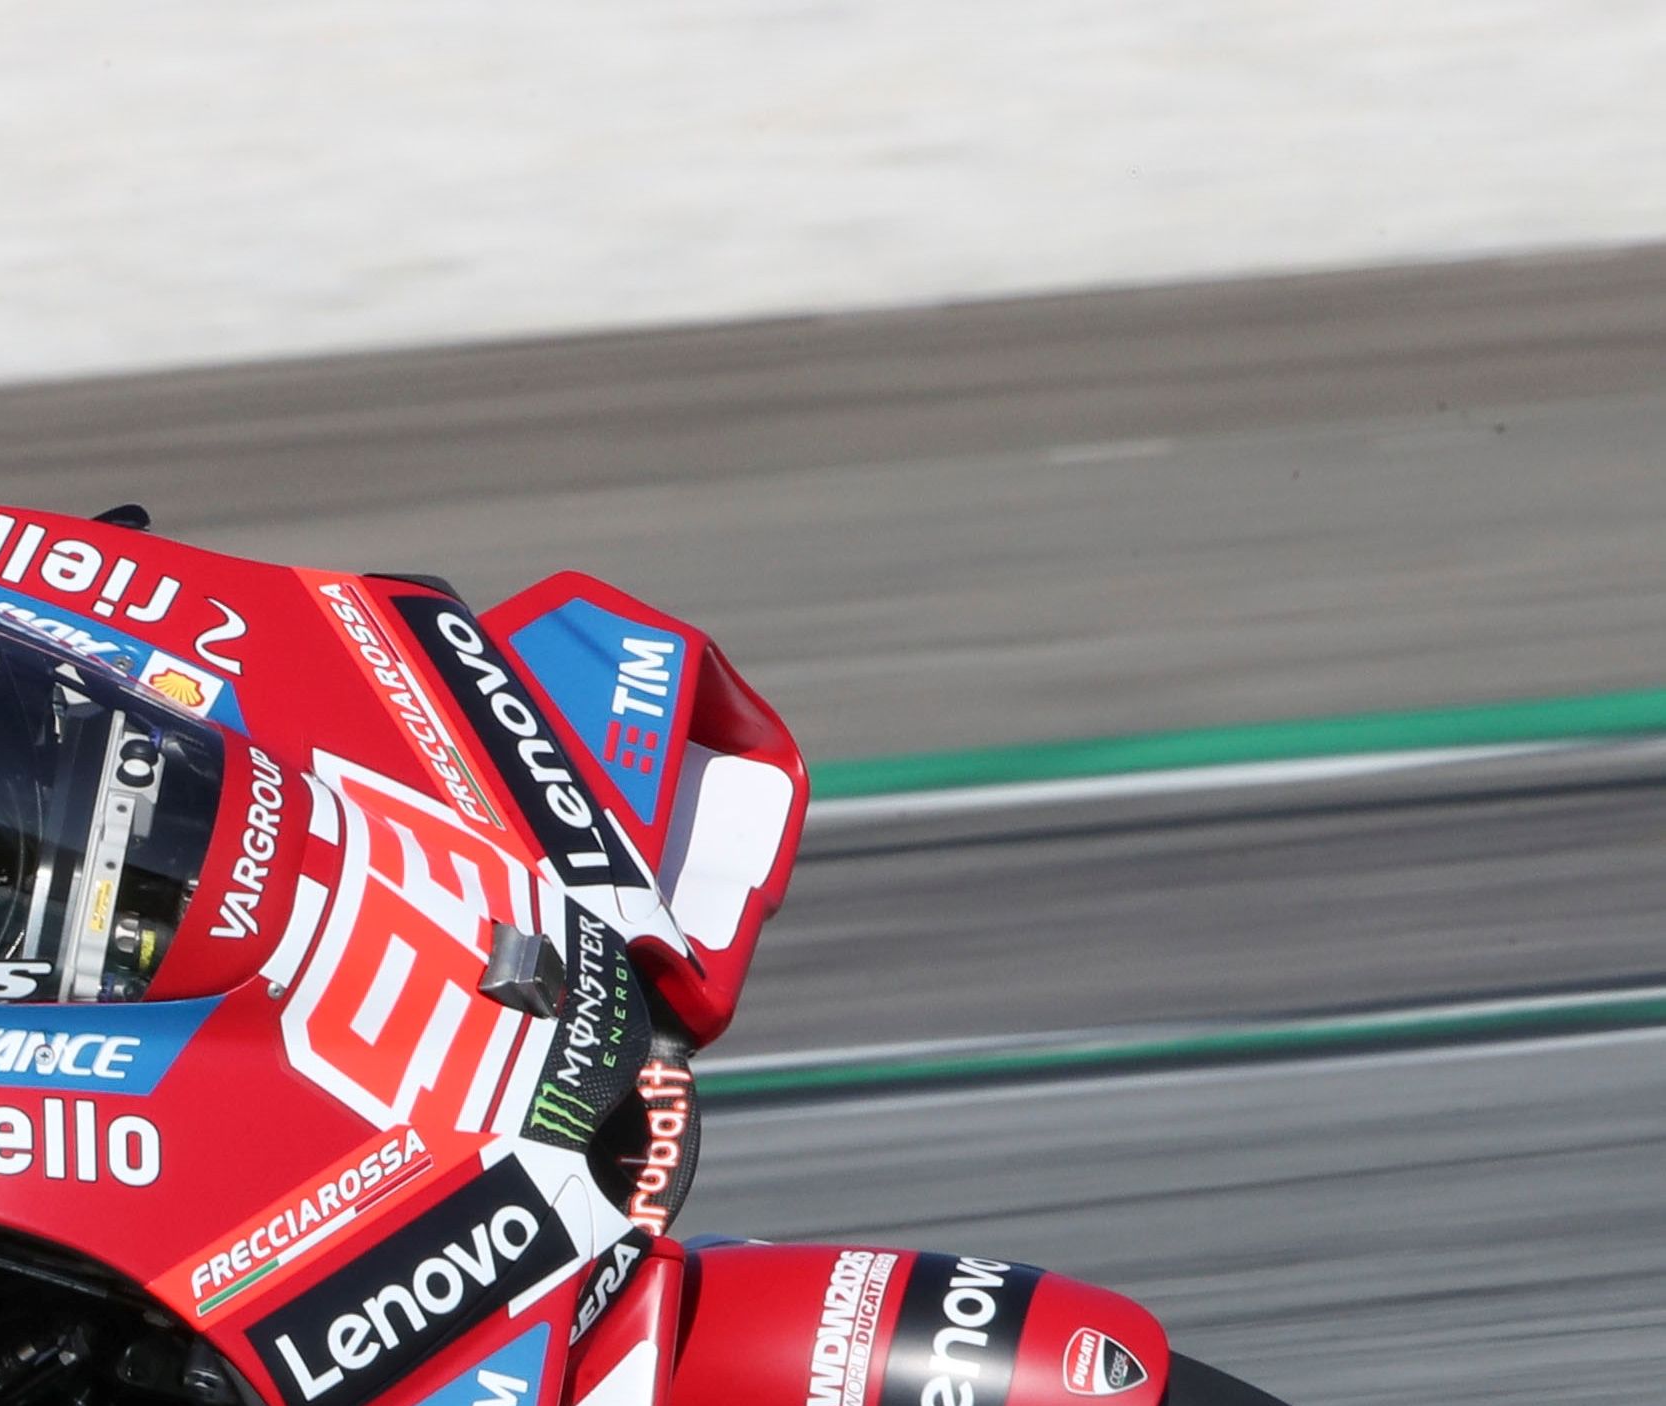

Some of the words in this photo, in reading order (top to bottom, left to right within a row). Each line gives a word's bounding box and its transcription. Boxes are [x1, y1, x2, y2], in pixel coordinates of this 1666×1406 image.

[319, 584, 489, 826] FRECCIAROSSA
[437, 612, 609, 868] Lenovo
[612, 637, 674, 717] TIM
[210, 747, 284, 941] VARGROUP
[557, 915, 607, 1088] MONSTER
[603, 951, 628, 1068] ENERGY
[190, 1128, 427, 1298] FRECCIAROSSA
[630, 1061, 692, 1236] aruba.it
[274, 1204, 539, 1401] Lenovo
[1072, 1333, 1096, 1387] DUCATI
